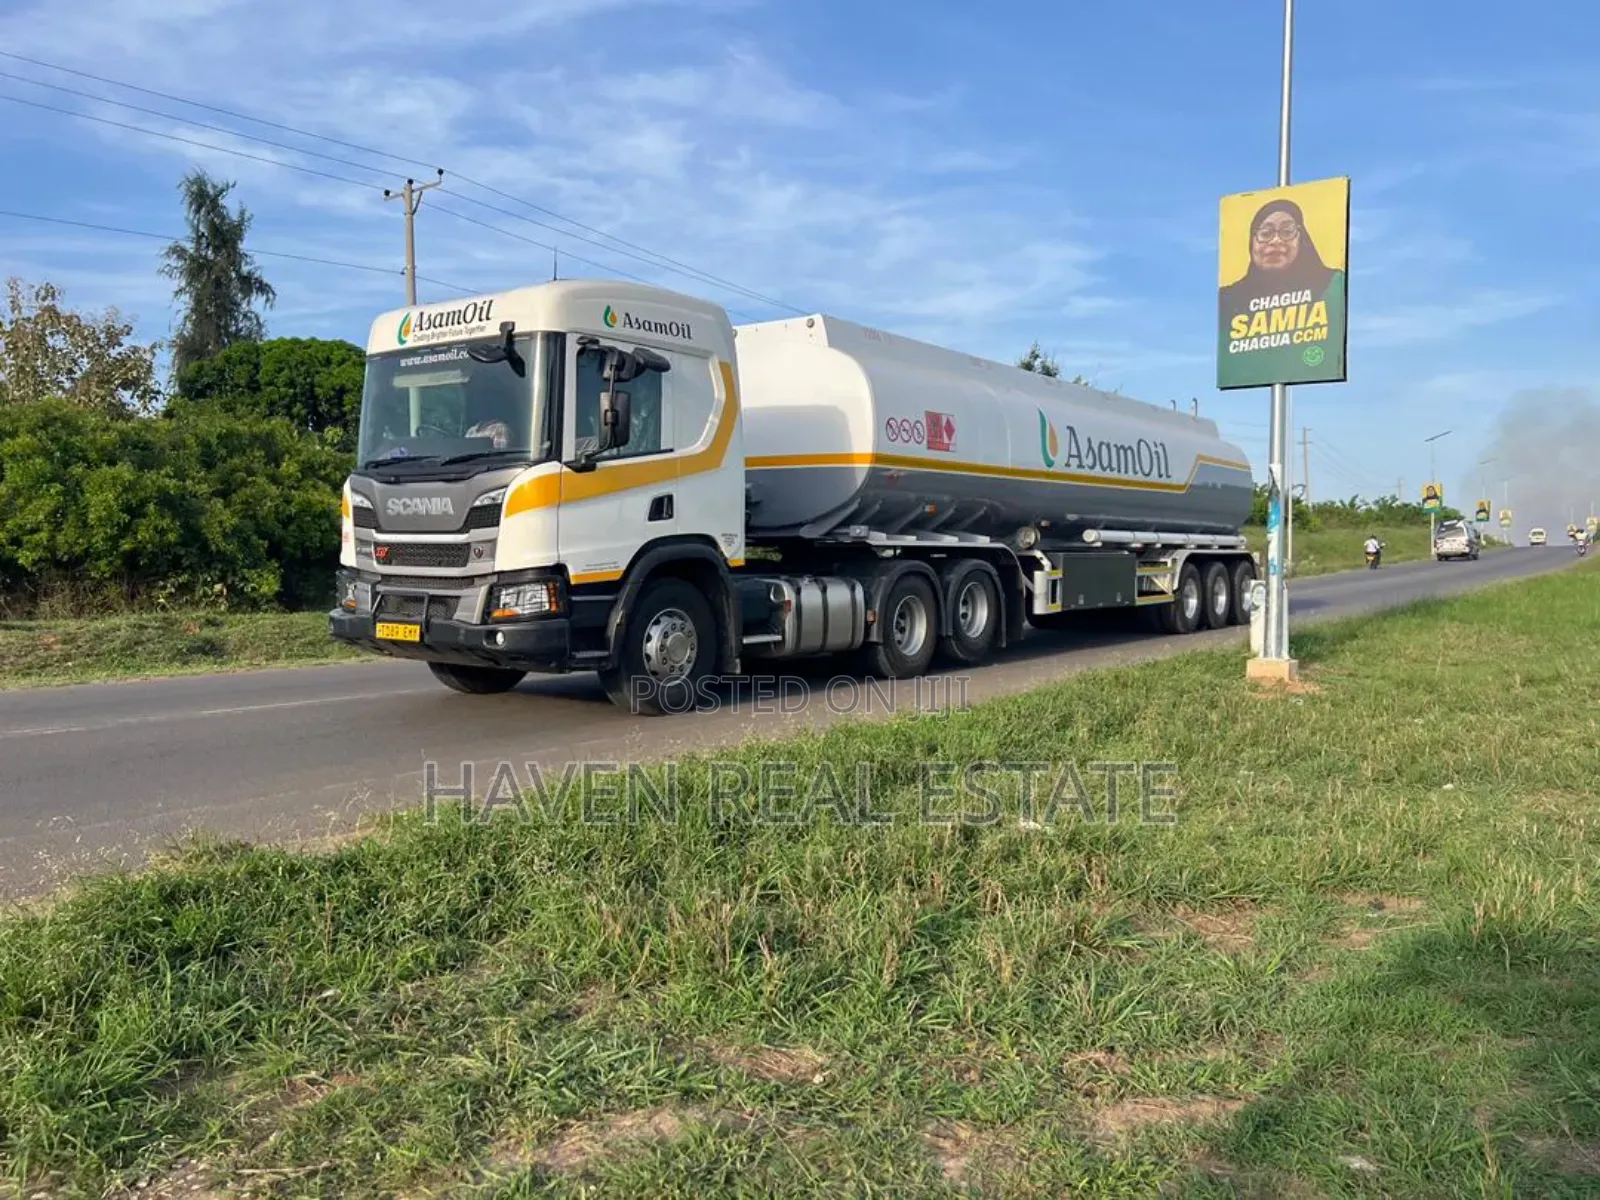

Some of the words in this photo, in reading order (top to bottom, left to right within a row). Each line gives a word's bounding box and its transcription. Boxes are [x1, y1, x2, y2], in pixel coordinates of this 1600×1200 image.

[1249, 289, 1312, 311] CHAGUA
[413, 299, 494, 332] AsamOil
[623, 312, 692, 339] AsamOil
[1230, 300, 1328, 339] SAMIA
[1229, 332, 1291, 353] CHAGUA
[1293, 326, 1328, 344] CCM
[1065, 425, 1172, 479] AsamOil
[386, 497, 455, 515] SCANIA
